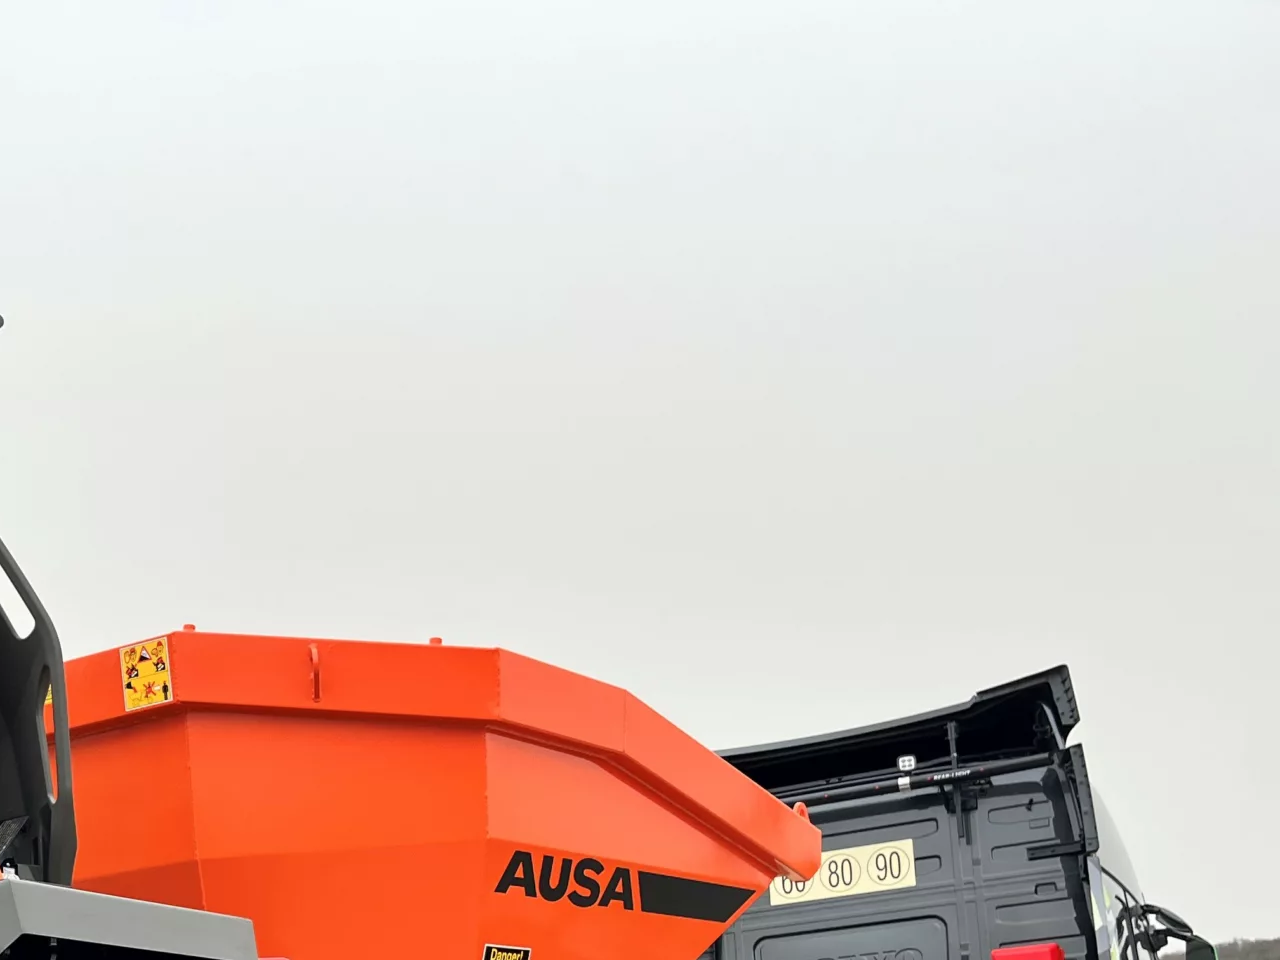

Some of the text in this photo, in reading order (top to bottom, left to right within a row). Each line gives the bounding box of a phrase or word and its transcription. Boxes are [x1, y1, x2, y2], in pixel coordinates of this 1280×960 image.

[494, 849, 634, 911] AUSA
[828, 858, 853, 888] 80
[875, 850, 901, 881] 90
